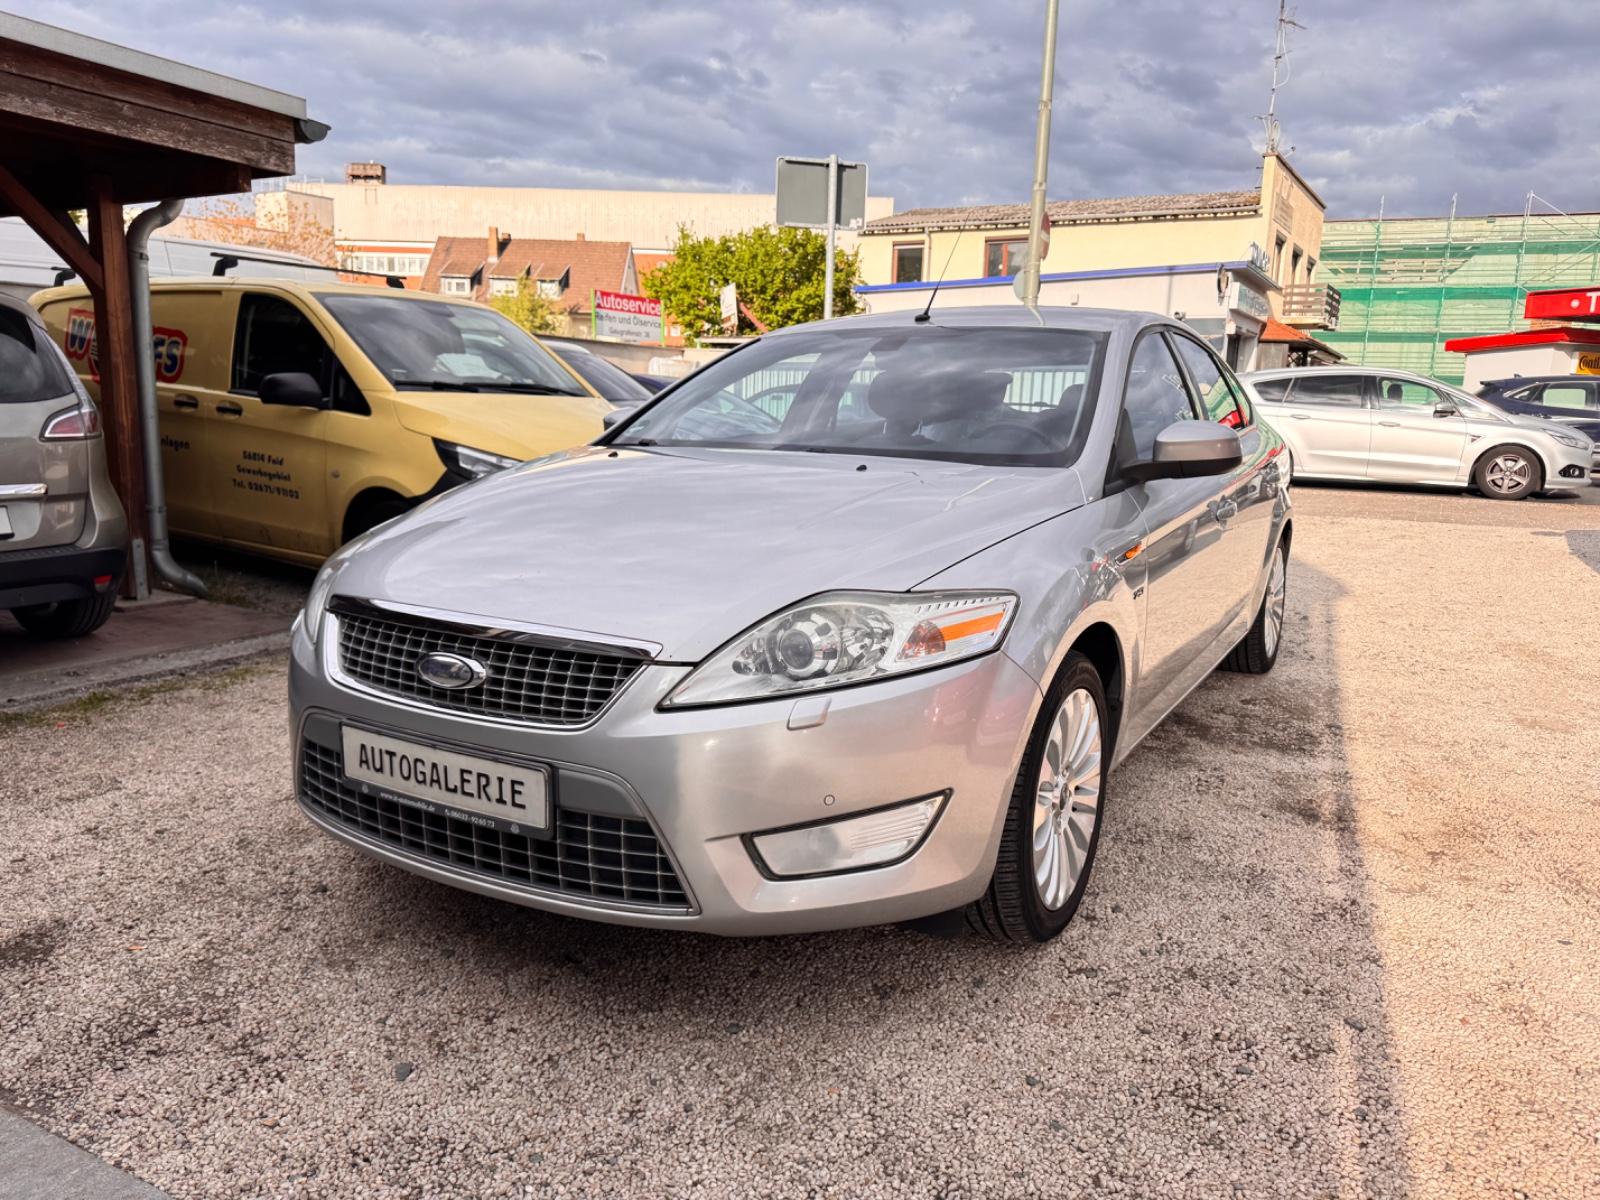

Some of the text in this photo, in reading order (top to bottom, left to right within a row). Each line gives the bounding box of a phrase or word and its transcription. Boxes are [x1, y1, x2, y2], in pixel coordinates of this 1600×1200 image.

[596, 290, 661, 316] Autoservice
[619, 315, 632, 325] und
[359, 743, 527, 809] AUTOGALERIE
